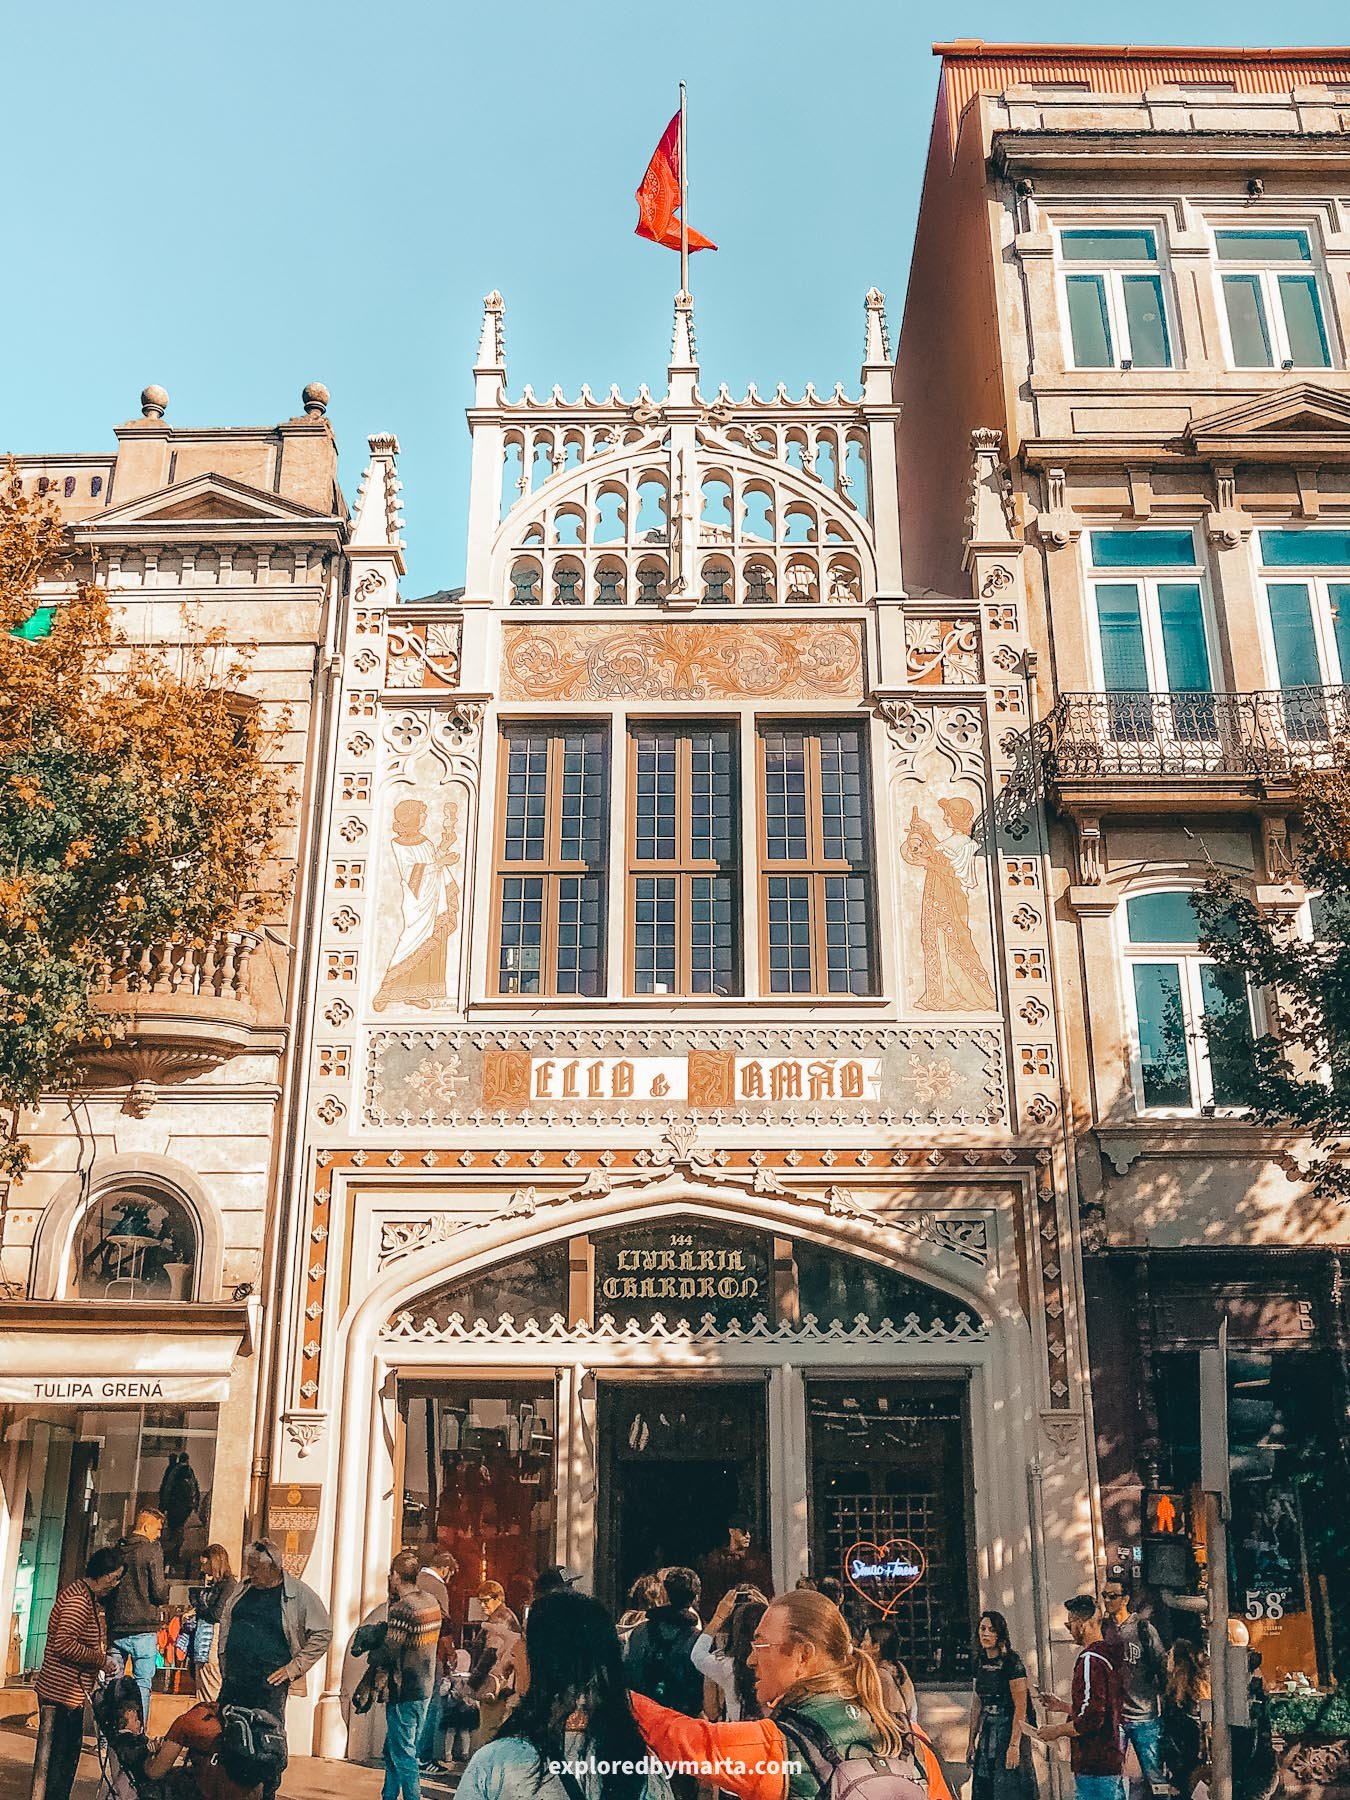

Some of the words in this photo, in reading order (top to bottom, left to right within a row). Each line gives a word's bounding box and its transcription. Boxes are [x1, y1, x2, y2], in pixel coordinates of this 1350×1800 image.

[486, 1051, 635, 1104] LELLO
[649, 1072, 671, 1097] &
[669, 1234, 694, 1247] 144
[616, 1249, 747, 1272] LIVRARIA
[602, 1276, 759, 1300] CHARDRON
[33, 1382, 94, 1398] TULIPA
[101, 1379, 164, 1398] GRENÁ
